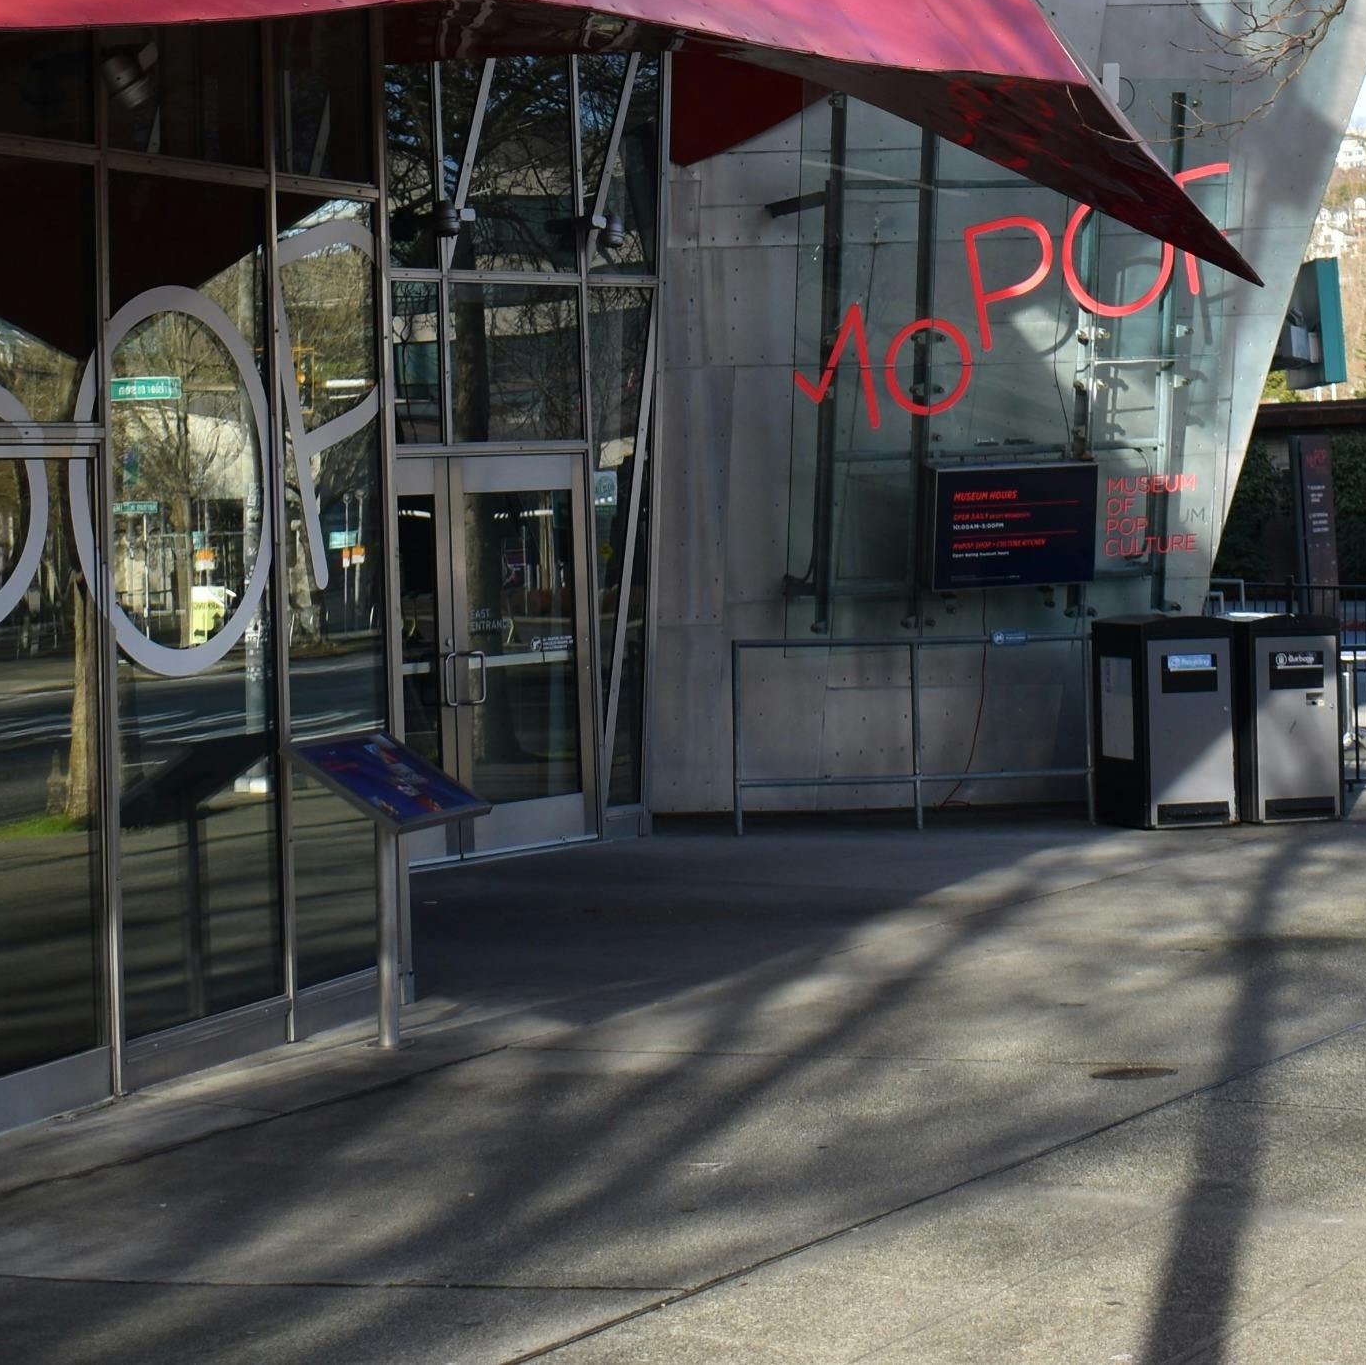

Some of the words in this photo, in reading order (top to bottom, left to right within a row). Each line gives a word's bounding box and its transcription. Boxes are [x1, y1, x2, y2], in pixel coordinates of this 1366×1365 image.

[1106, 473, 1197, 495] MUSEUM
[954, 491, 988, 502] MUSEUM
[989, 489, 1018, 501] HOURS
[1106, 497, 1135, 517] OF
[1106, 516, 1149, 536] POP
[1104, 532, 1199, 558] CULTURE
